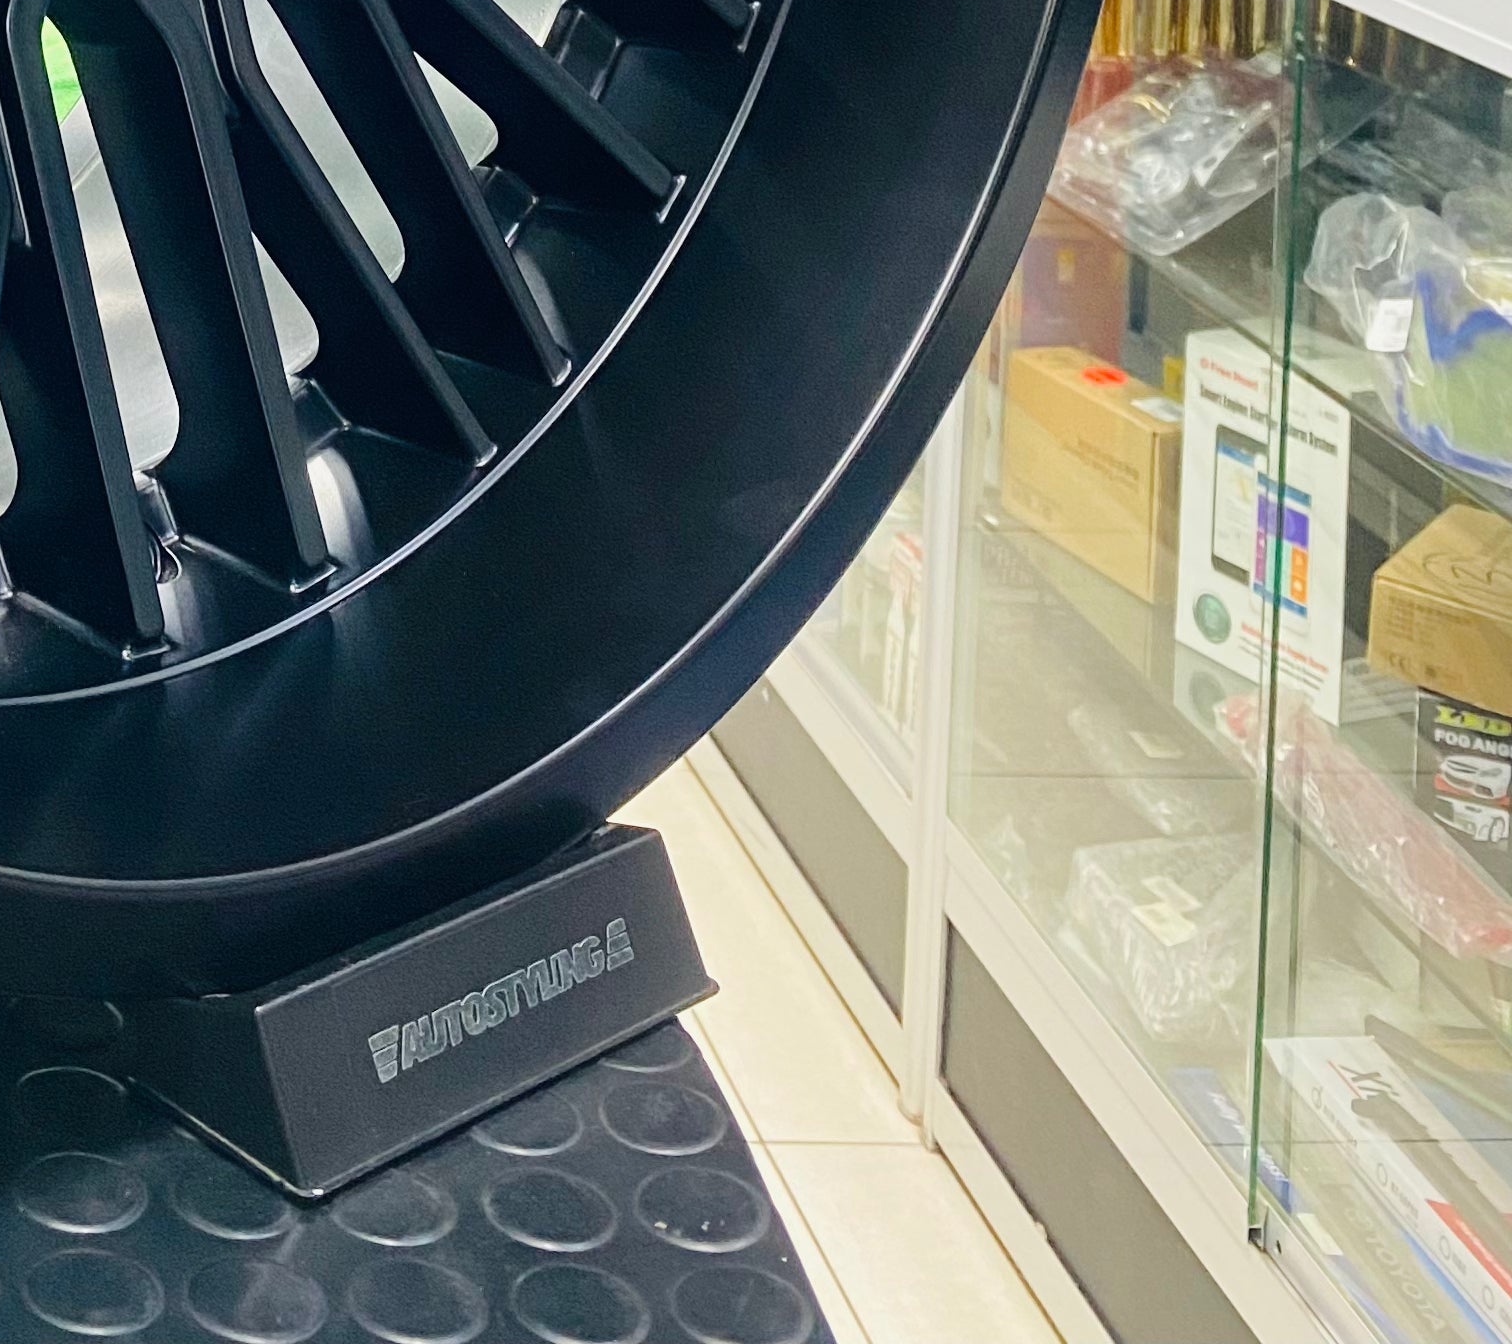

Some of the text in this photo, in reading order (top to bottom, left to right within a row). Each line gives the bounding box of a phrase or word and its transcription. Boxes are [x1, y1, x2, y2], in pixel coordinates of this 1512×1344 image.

[1434, 728, 1512, 759] FOG ANG
[400, 934, 606, 1072] AUTOSTYLING
